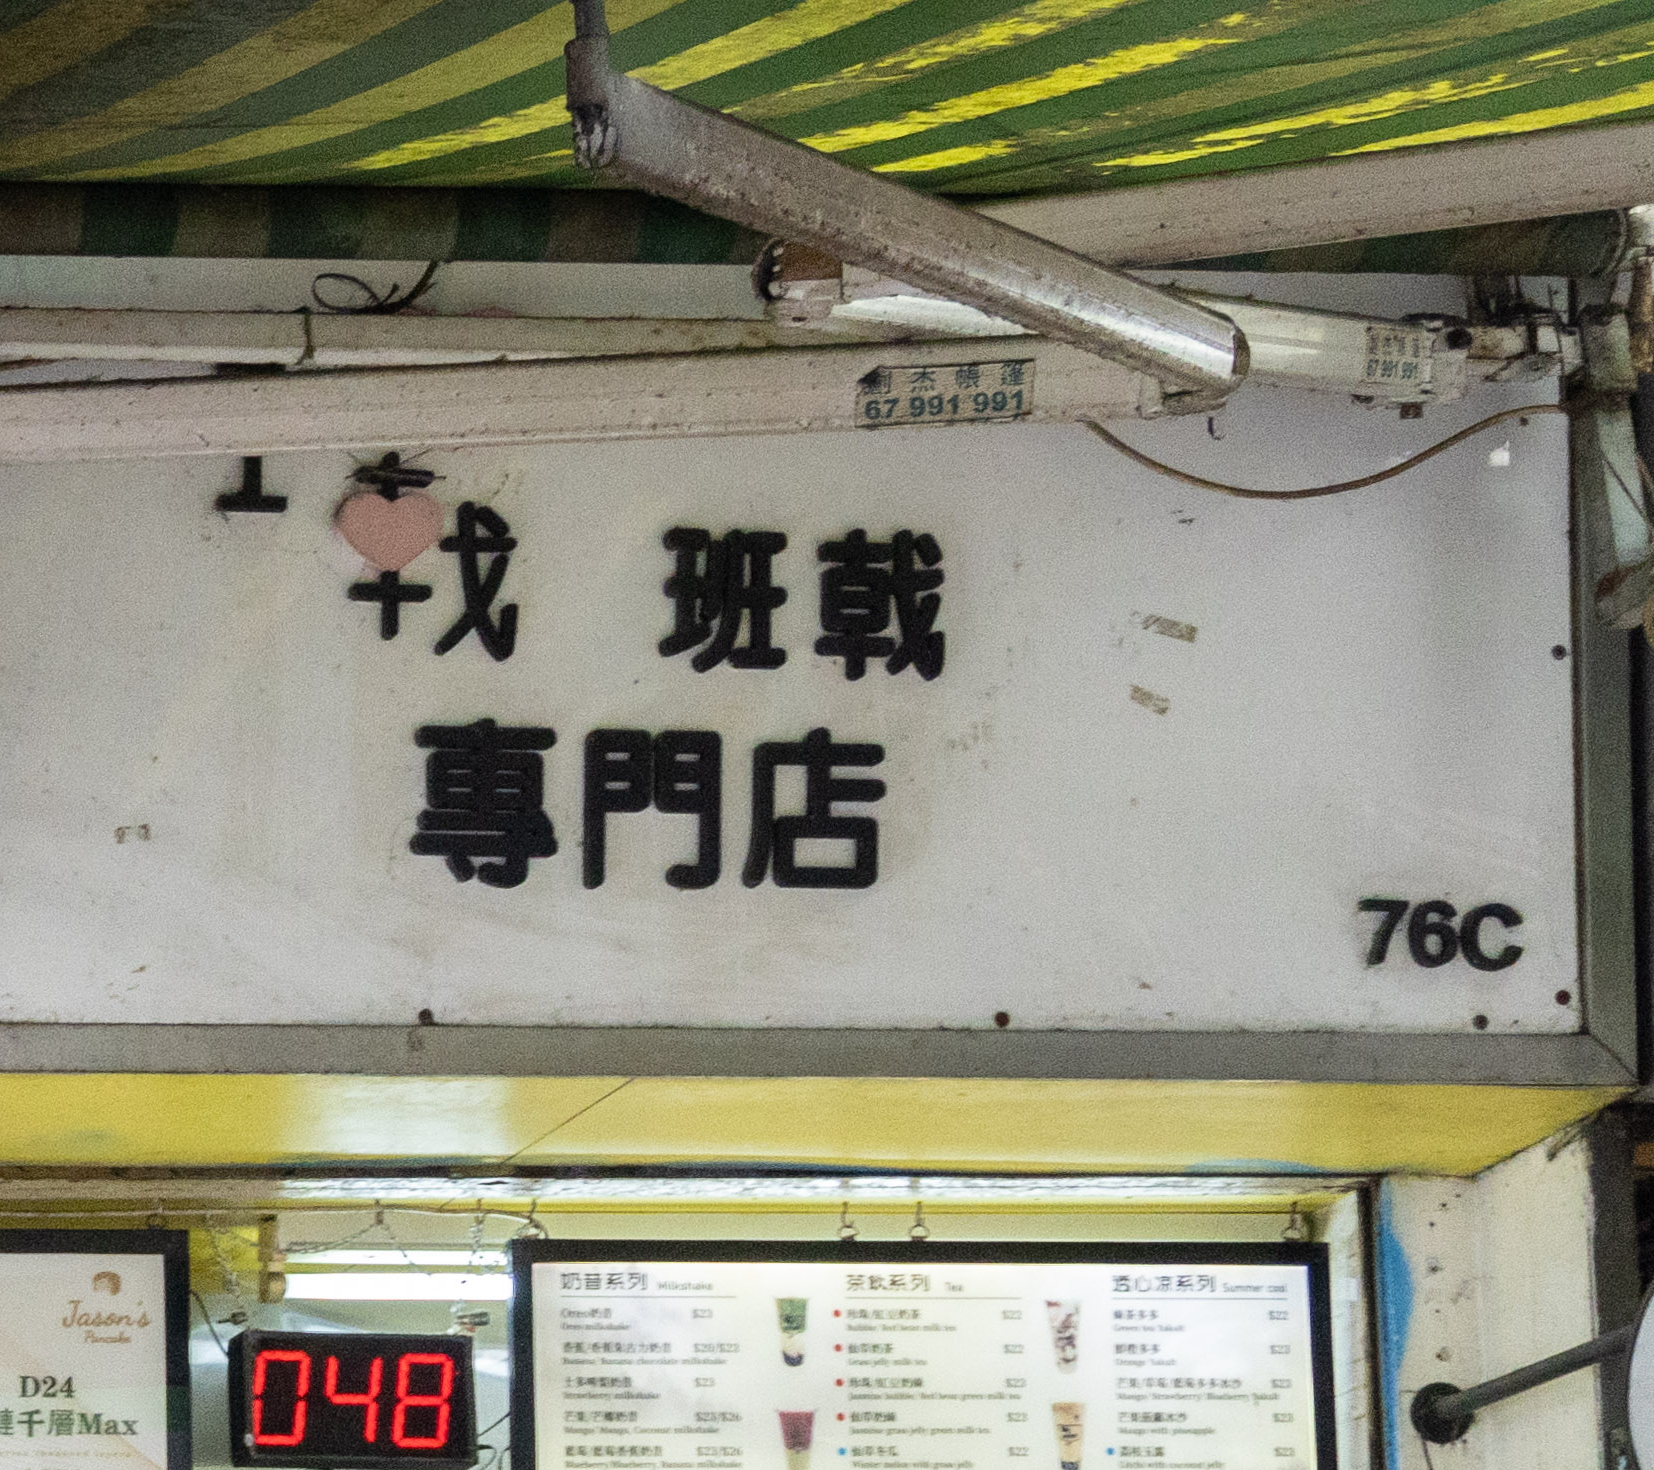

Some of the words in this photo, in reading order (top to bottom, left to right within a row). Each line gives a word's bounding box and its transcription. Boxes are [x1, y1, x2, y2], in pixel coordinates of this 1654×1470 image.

[864, 396, 899, 420] 67
[909, 393, 960, 417] 991
[974, 390, 1025, 414] 991
[658, 525, 946, 680] 班戟
[409, 719, 888, 892] 專門店
[1358, 899, 1525, 974] 76C
[19, 1375, 76, 1400] D24
[252, 1349, 454, 1449] 048
